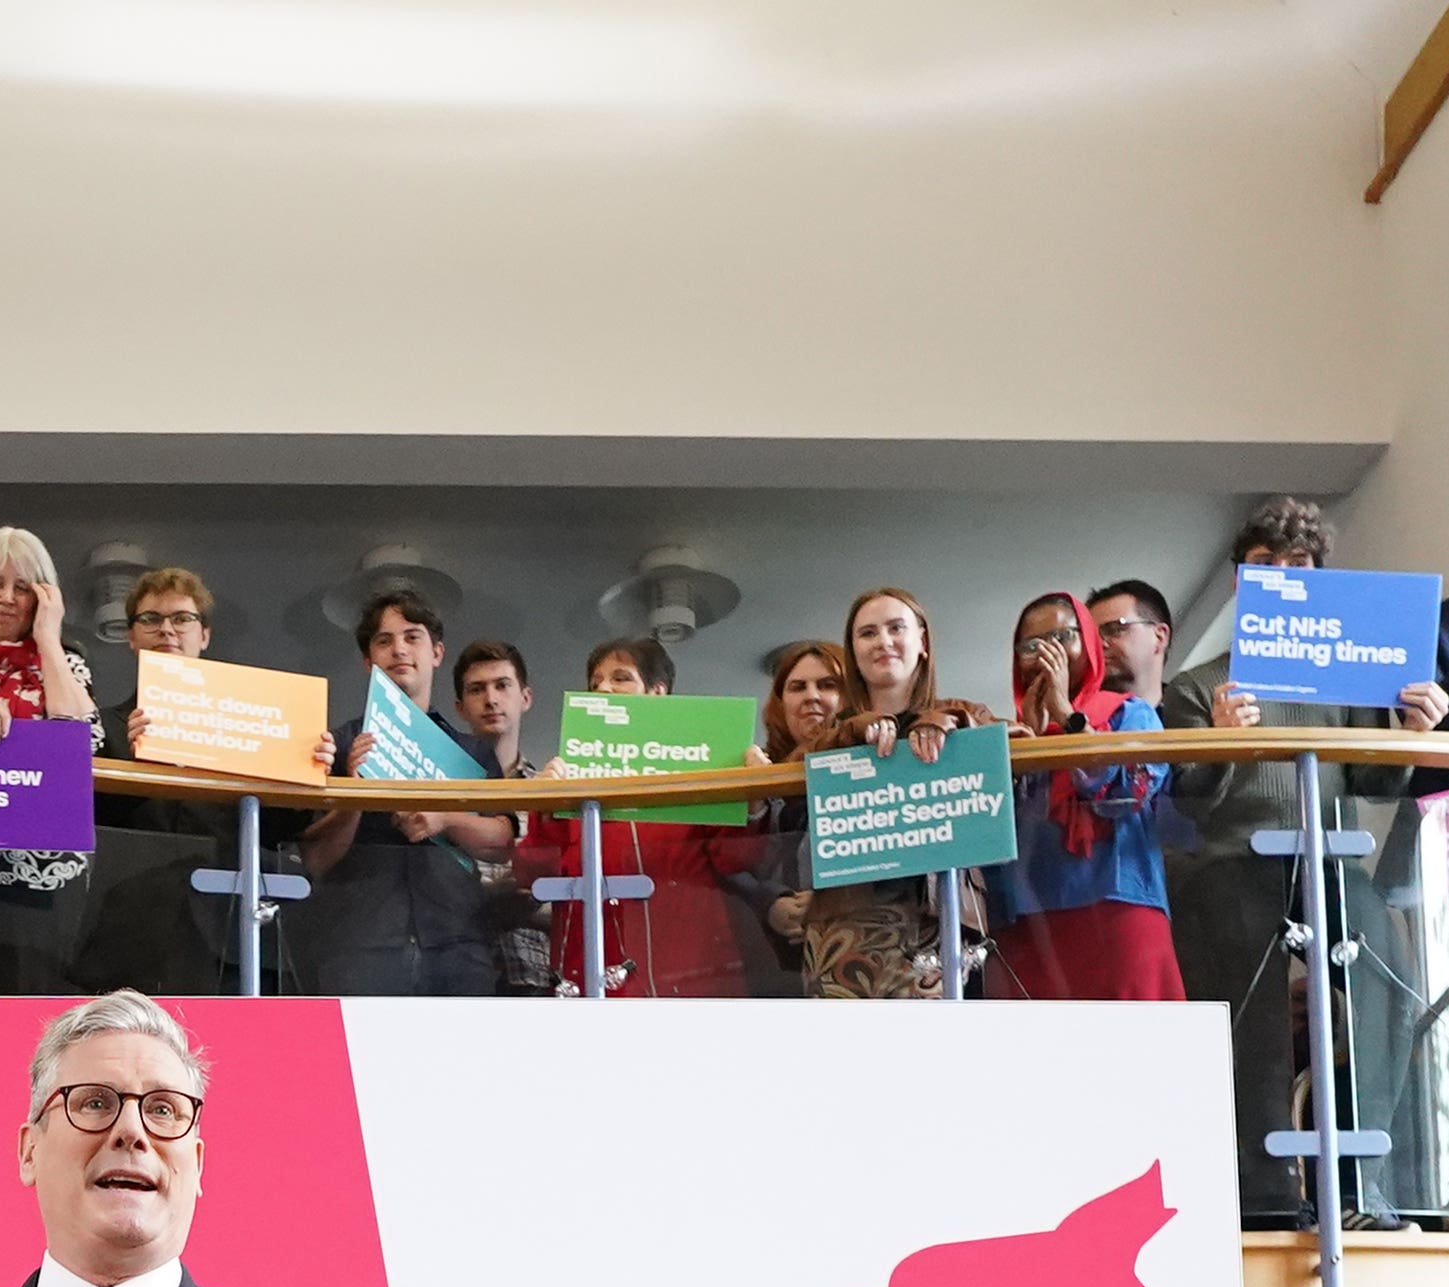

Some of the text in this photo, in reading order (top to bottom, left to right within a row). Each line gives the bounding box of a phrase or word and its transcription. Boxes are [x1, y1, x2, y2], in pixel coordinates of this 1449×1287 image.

[1240, 613, 1342, 639] Cut NHS
[1238, 636, 1407, 667] waiting times
[144, 685, 282, 720] Crack down
[144, 705, 290, 739] on antisocial
[371, 702, 423, 765] Launch
[566, 738, 710, 764] Set up Great
[814, 772, 984, 814] Launch a new
[816, 791, 1004, 837] Border Security
[817, 821, 953, 859] Command
